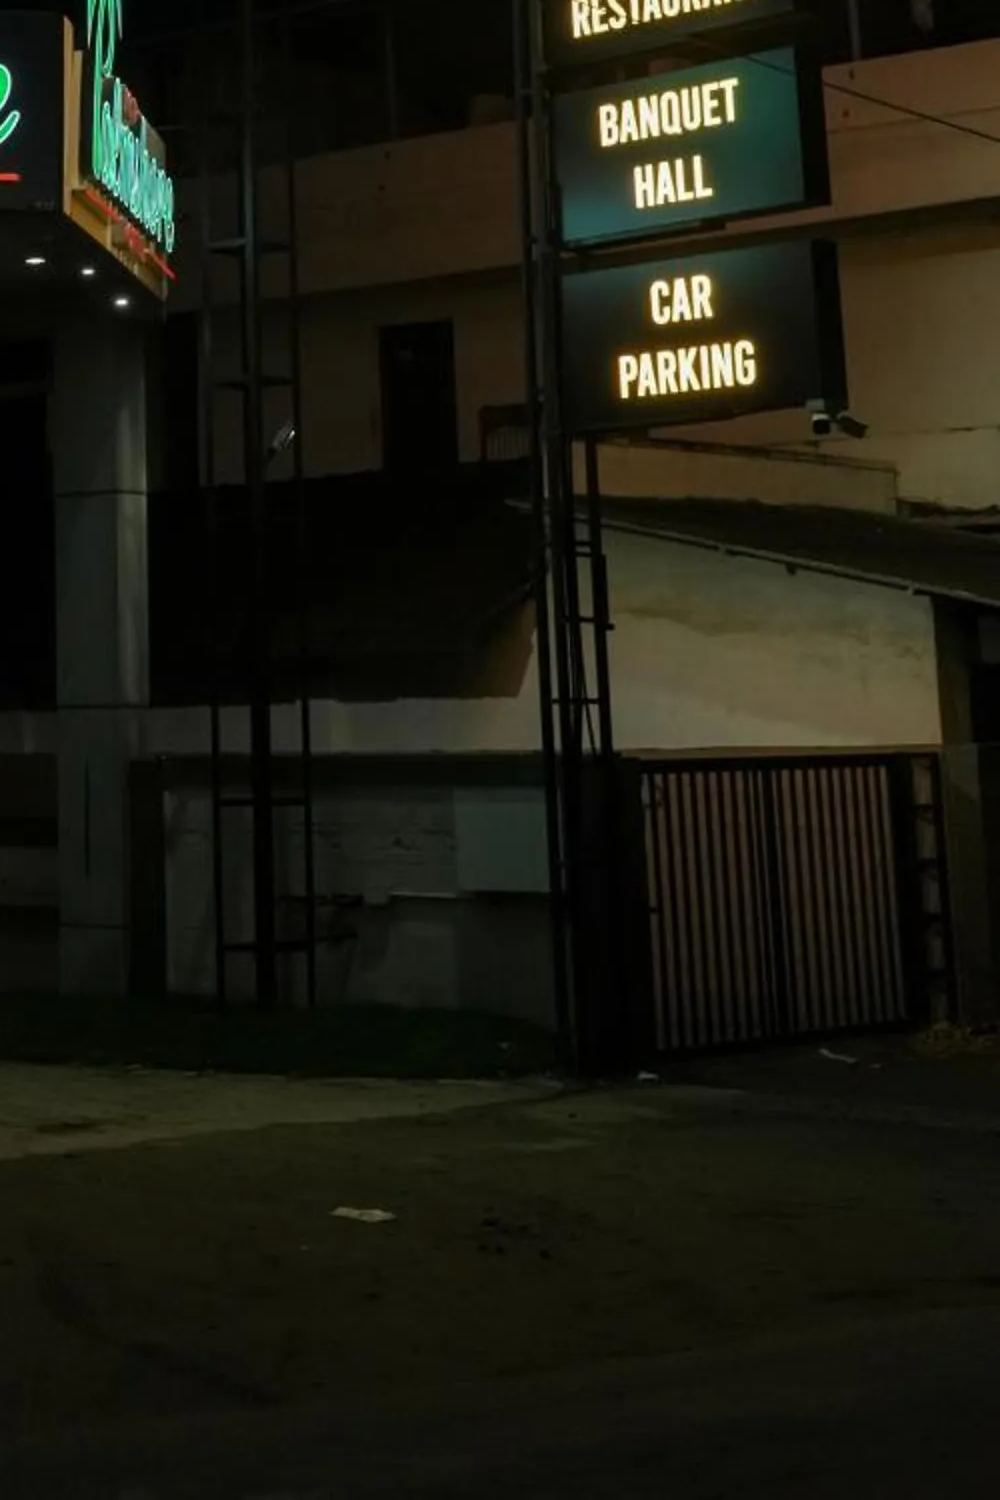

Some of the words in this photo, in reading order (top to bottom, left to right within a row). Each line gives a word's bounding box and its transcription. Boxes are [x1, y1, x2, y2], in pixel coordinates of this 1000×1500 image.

[598, 77, 739, 147] BANQUET
[633, 154, 713, 209] HALL
[649, 274, 714, 325] CAR
[617, 339, 757, 399] PARKING
